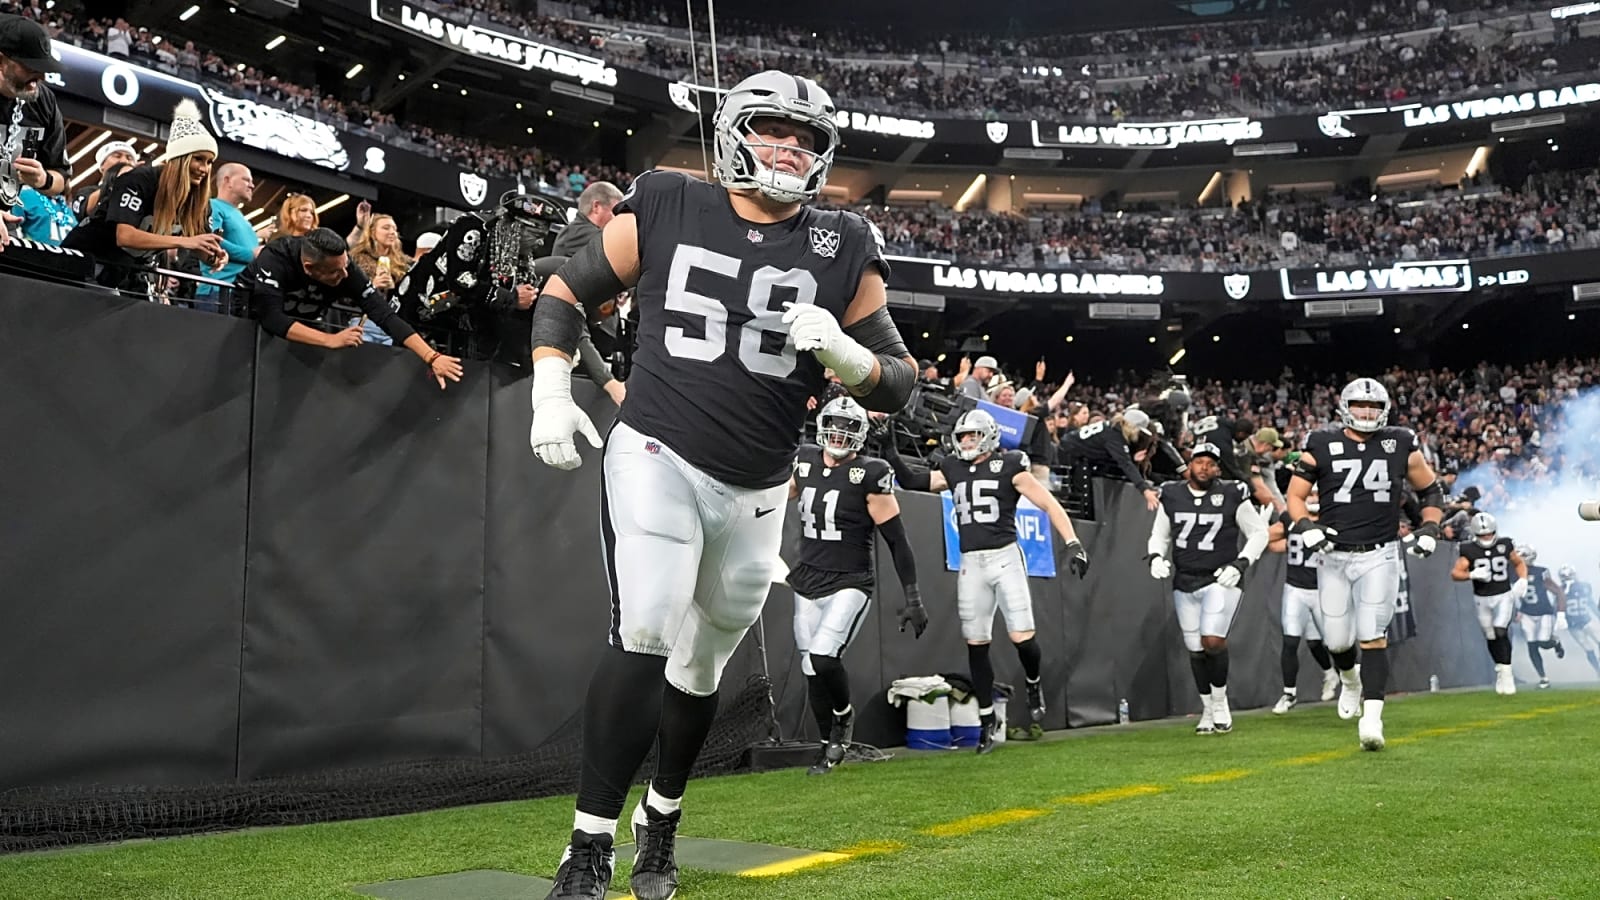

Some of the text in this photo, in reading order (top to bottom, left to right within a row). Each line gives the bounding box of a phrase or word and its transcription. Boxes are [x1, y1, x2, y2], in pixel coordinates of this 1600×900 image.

[401, 5, 445, 38] LAS
[446, 23, 521, 61] VEGAS
[102, 64, 139, 106] 0
[852, 112, 935, 139] RAIDERS
[1404, 104, 1451, 127] LAS
[1452, 92, 1535, 120] VEGAS
[1058, 126, 1098, 143] LAS
[1099, 126, 1168, 145] VEGAS
[119, 193, 143, 212] 98
[933, 266, 1164, 295] LAS VEGAS RAIDERS
[1316, 265, 1529, 292] LAS VEGAS LED
[664, 244, 818, 378] 58
[1332, 459, 1392, 503] 74
[798, 486, 843, 541] 41
[953, 479, 1000, 525] 45
[1174, 512, 1224, 551] 77
